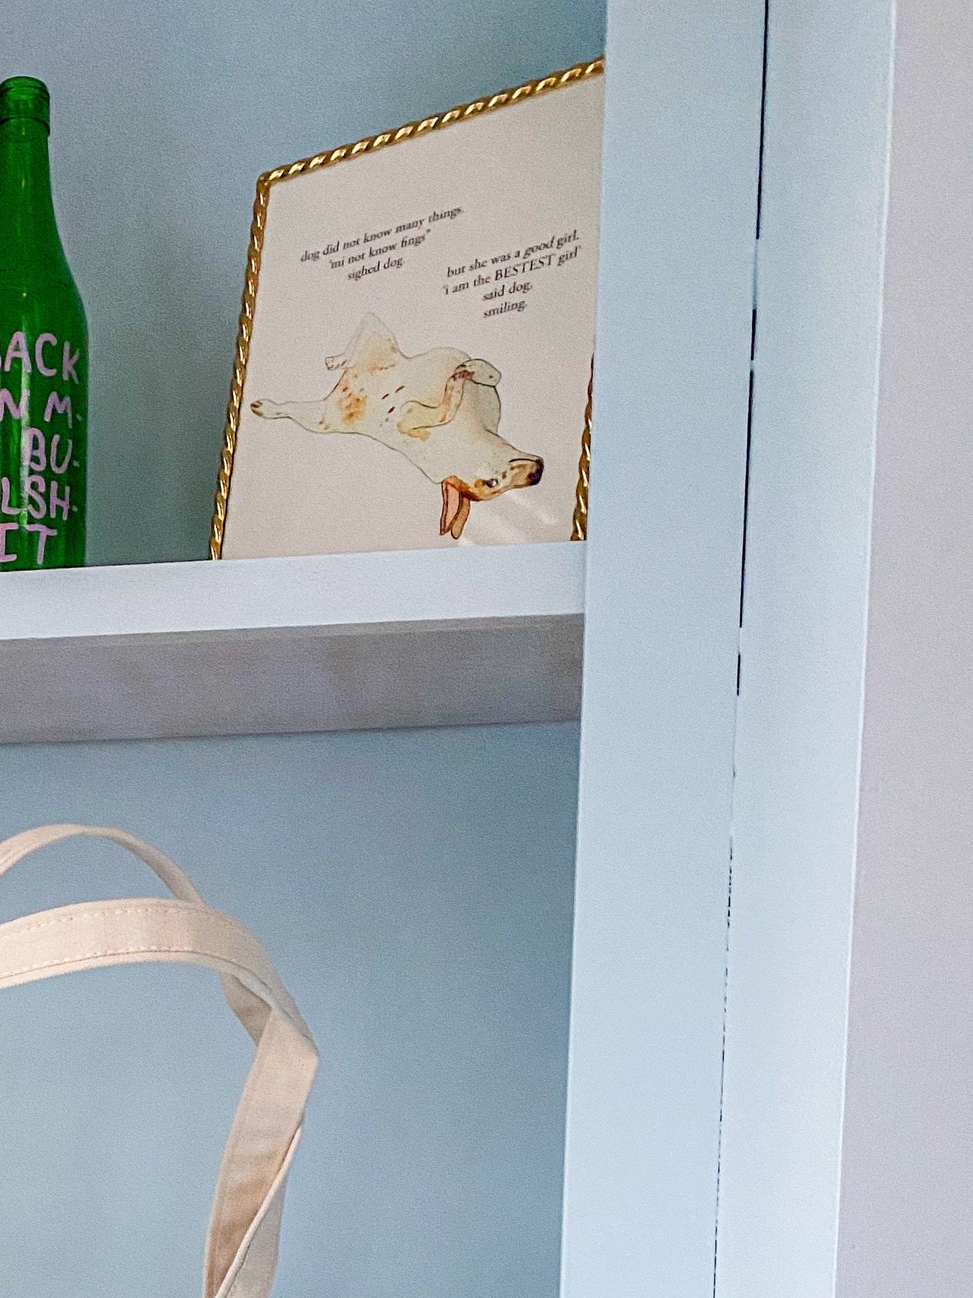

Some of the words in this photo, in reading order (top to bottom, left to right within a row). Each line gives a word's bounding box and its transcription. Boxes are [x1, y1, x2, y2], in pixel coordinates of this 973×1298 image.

[300, 250, 320, 262] dog
[322, 241, 340, 256] did
[342, 238, 361, 250] not
[363, 228, 393, 244] know
[395, 218, 425, 234] many
[347, 252, 367, 265] not
[368, 243, 398, 258] know
[447, 265, 466, 278] but
[468, 258, 487, 271] she
[490, 252, 511, 265] was
[522, 235, 555, 259] good
[556, 229, 579, 249] girl.
[347, 261, 380, 281] sighed
[452, 280, 469, 293] am
[473, 274, 491, 287] the
[494, 253, 556, 281] BESTEST
[482, 284, 505, 301] said
